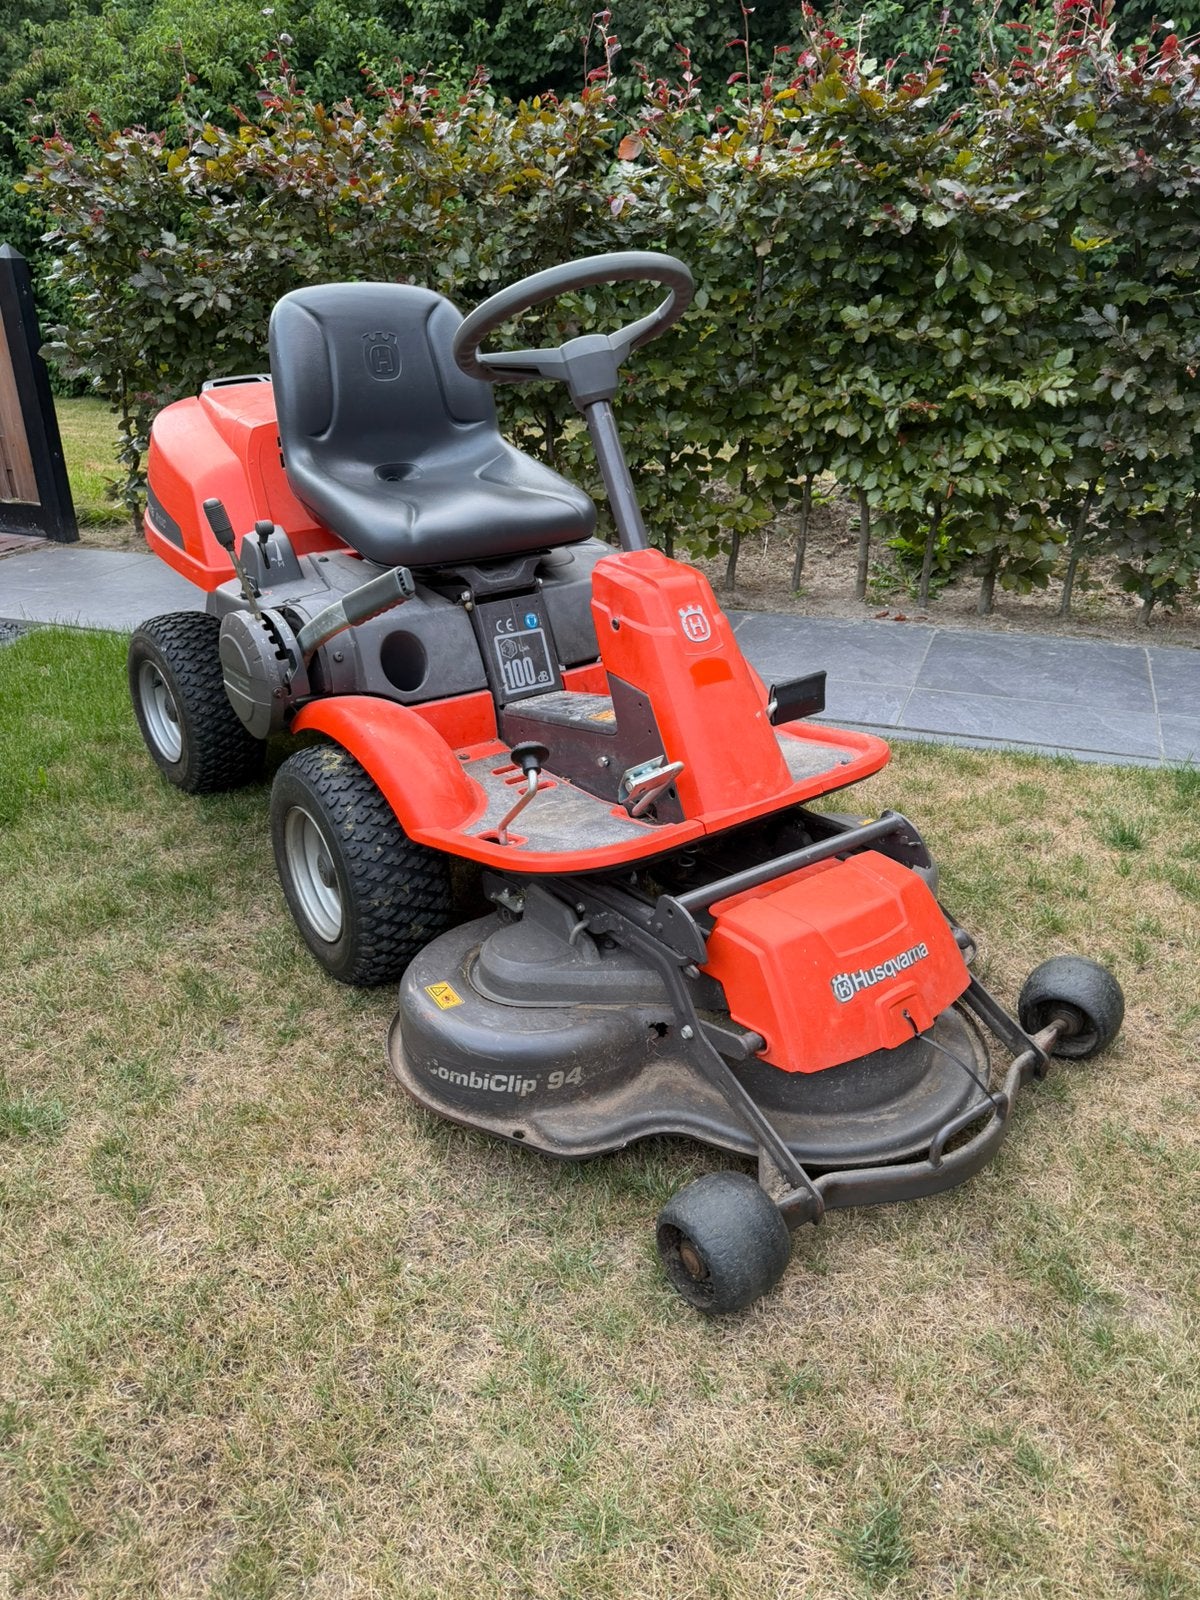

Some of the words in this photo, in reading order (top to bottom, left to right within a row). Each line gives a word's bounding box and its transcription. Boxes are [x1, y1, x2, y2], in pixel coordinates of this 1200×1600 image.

[495, 617, 515, 634] CE
[504, 656, 537, 688] 100
[849, 941, 929, 992] Husqvarna
[547, 1066, 583, 1090] 94
